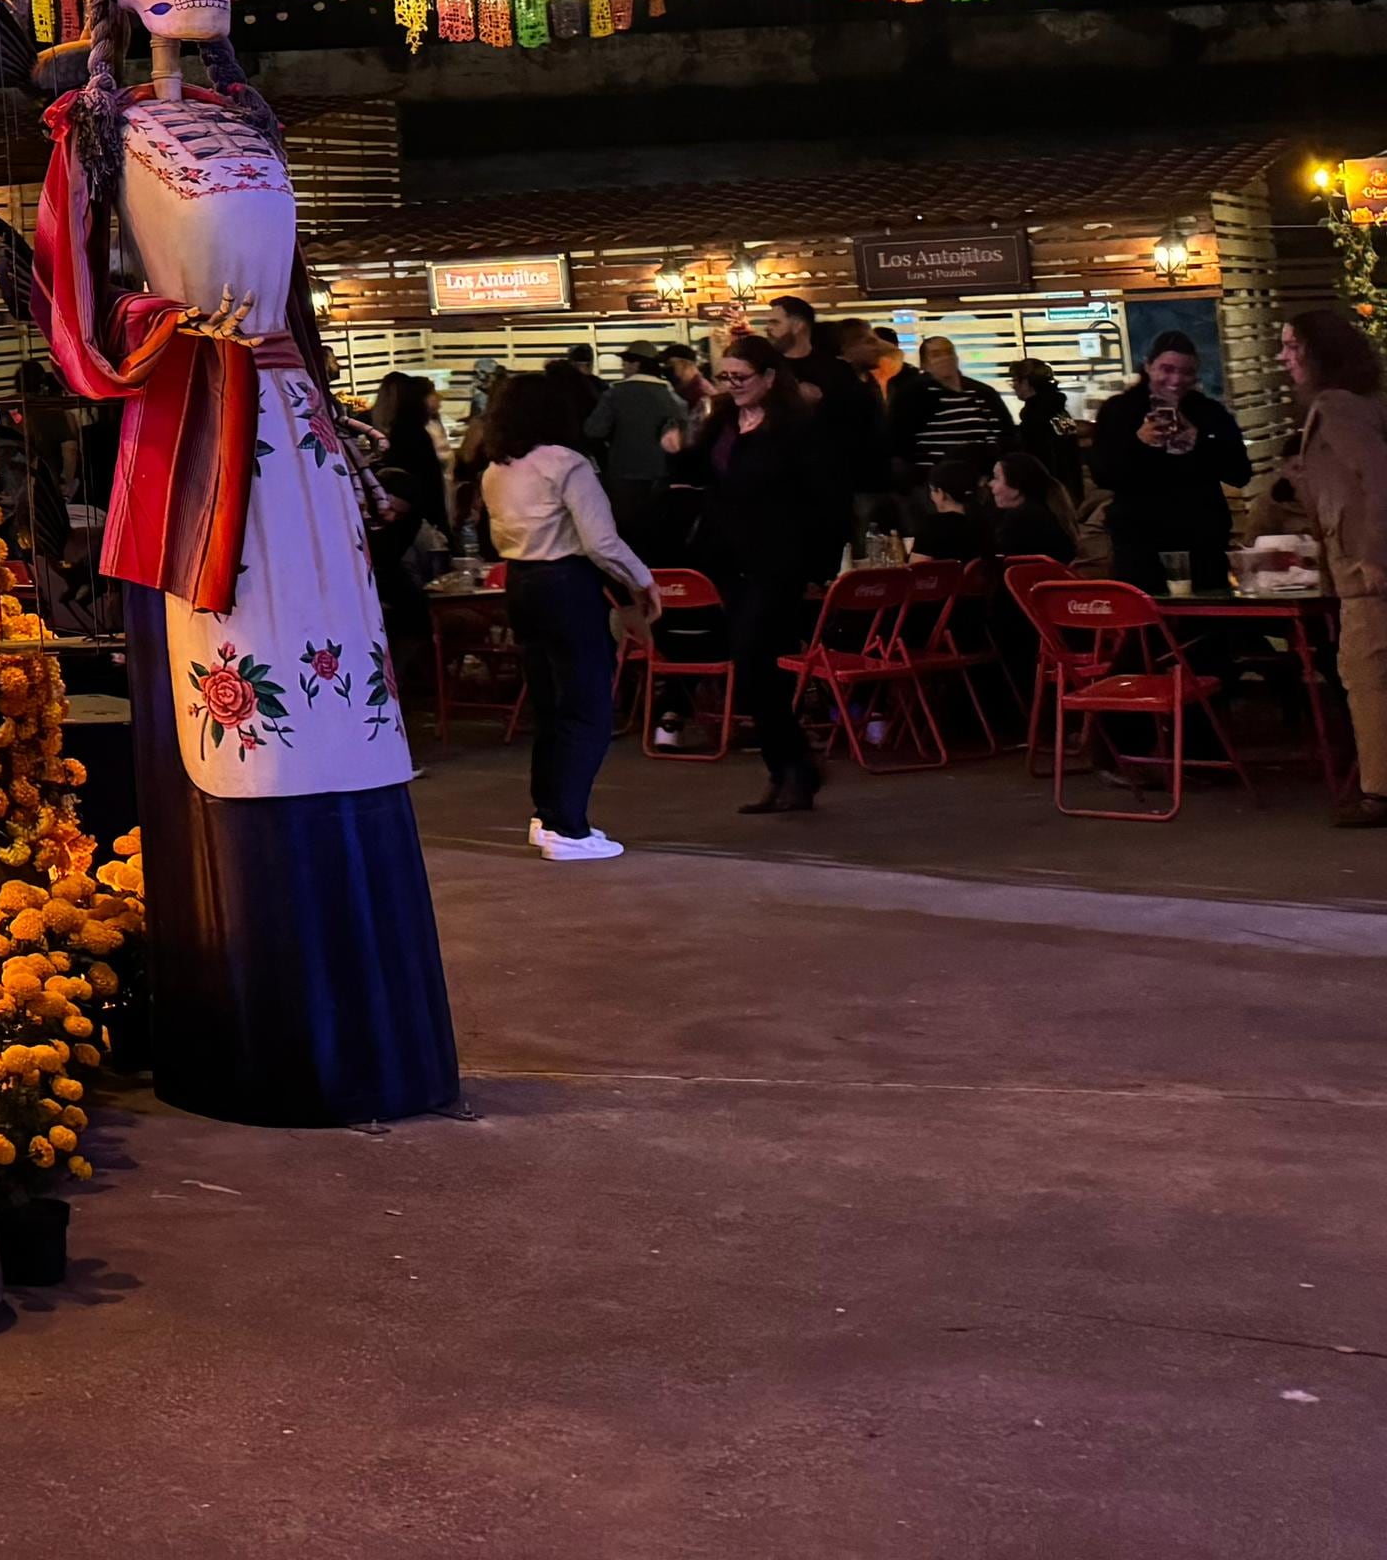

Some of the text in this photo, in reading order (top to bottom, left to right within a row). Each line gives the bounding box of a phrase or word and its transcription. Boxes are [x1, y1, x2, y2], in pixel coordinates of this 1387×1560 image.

[878, 247, 1004, 268] Los Antojitos
[445, 269, 549, 289] Los Antojitos
